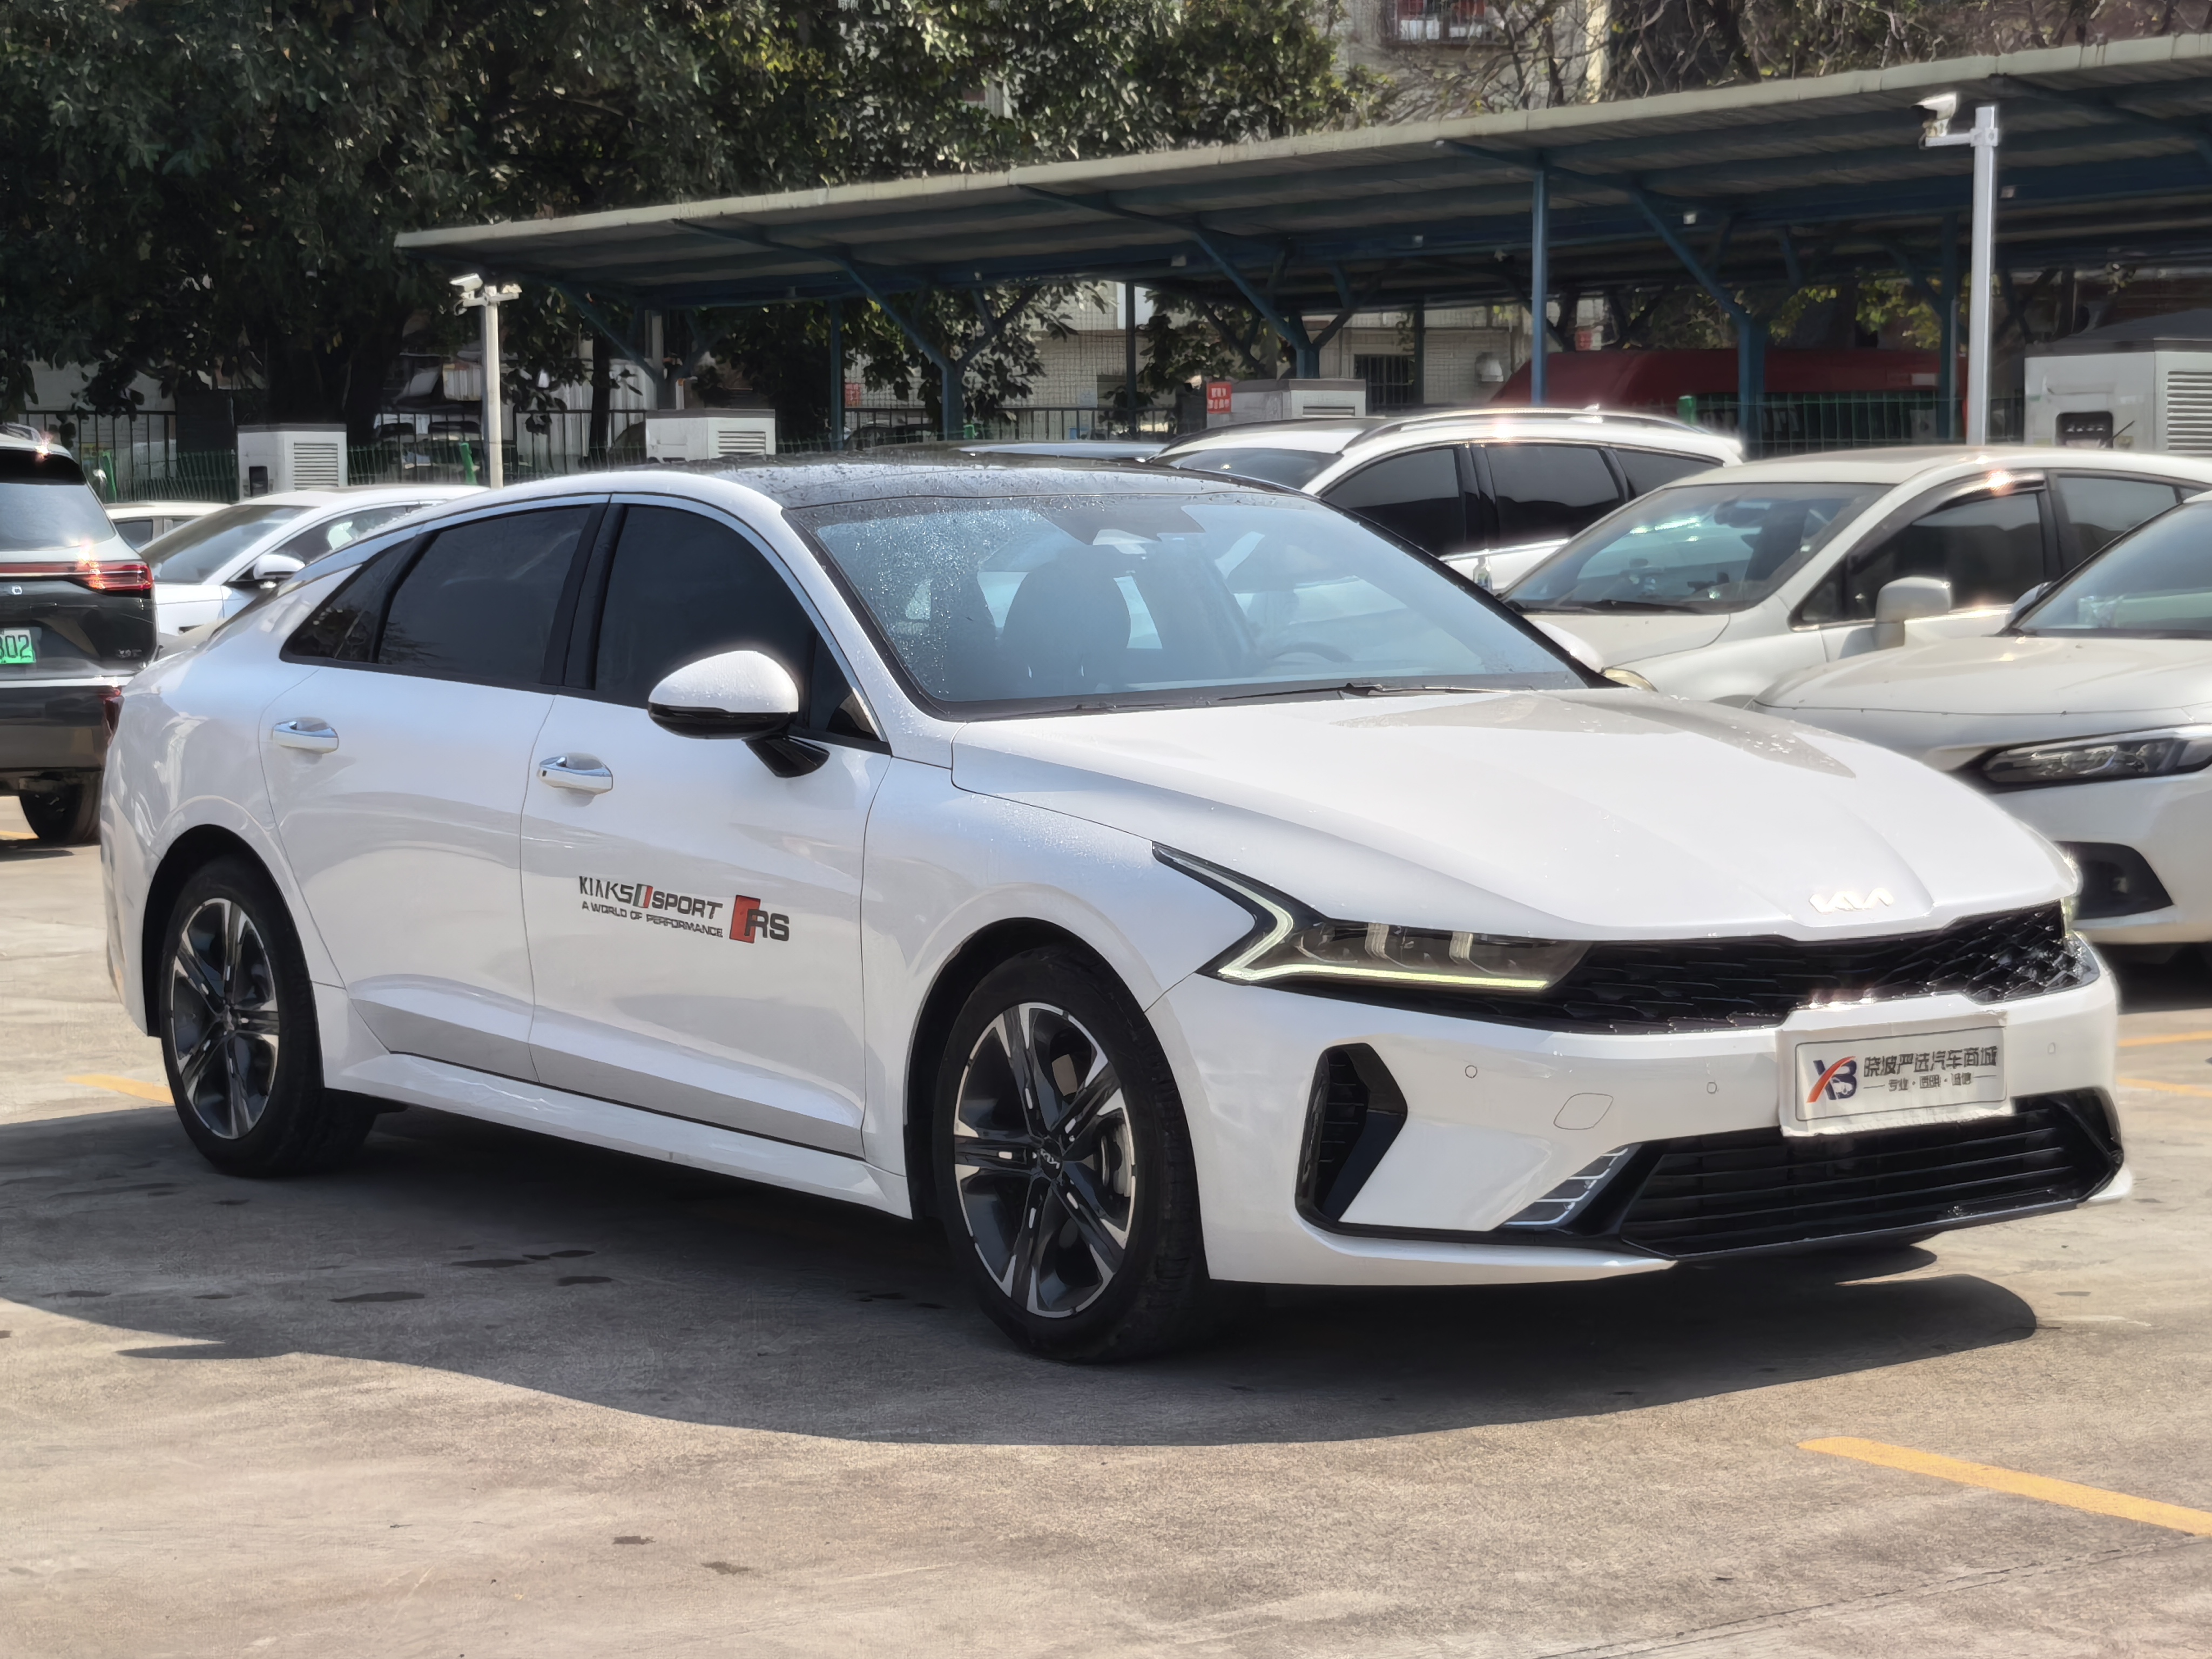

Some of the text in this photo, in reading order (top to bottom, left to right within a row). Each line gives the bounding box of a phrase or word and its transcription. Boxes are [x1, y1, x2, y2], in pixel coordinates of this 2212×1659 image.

[582, 901, 723, 938] A WORLD OF PERFORMANCE
[651, 891, 723, 919] SPORT
[744, 908, 790, 941] RS
